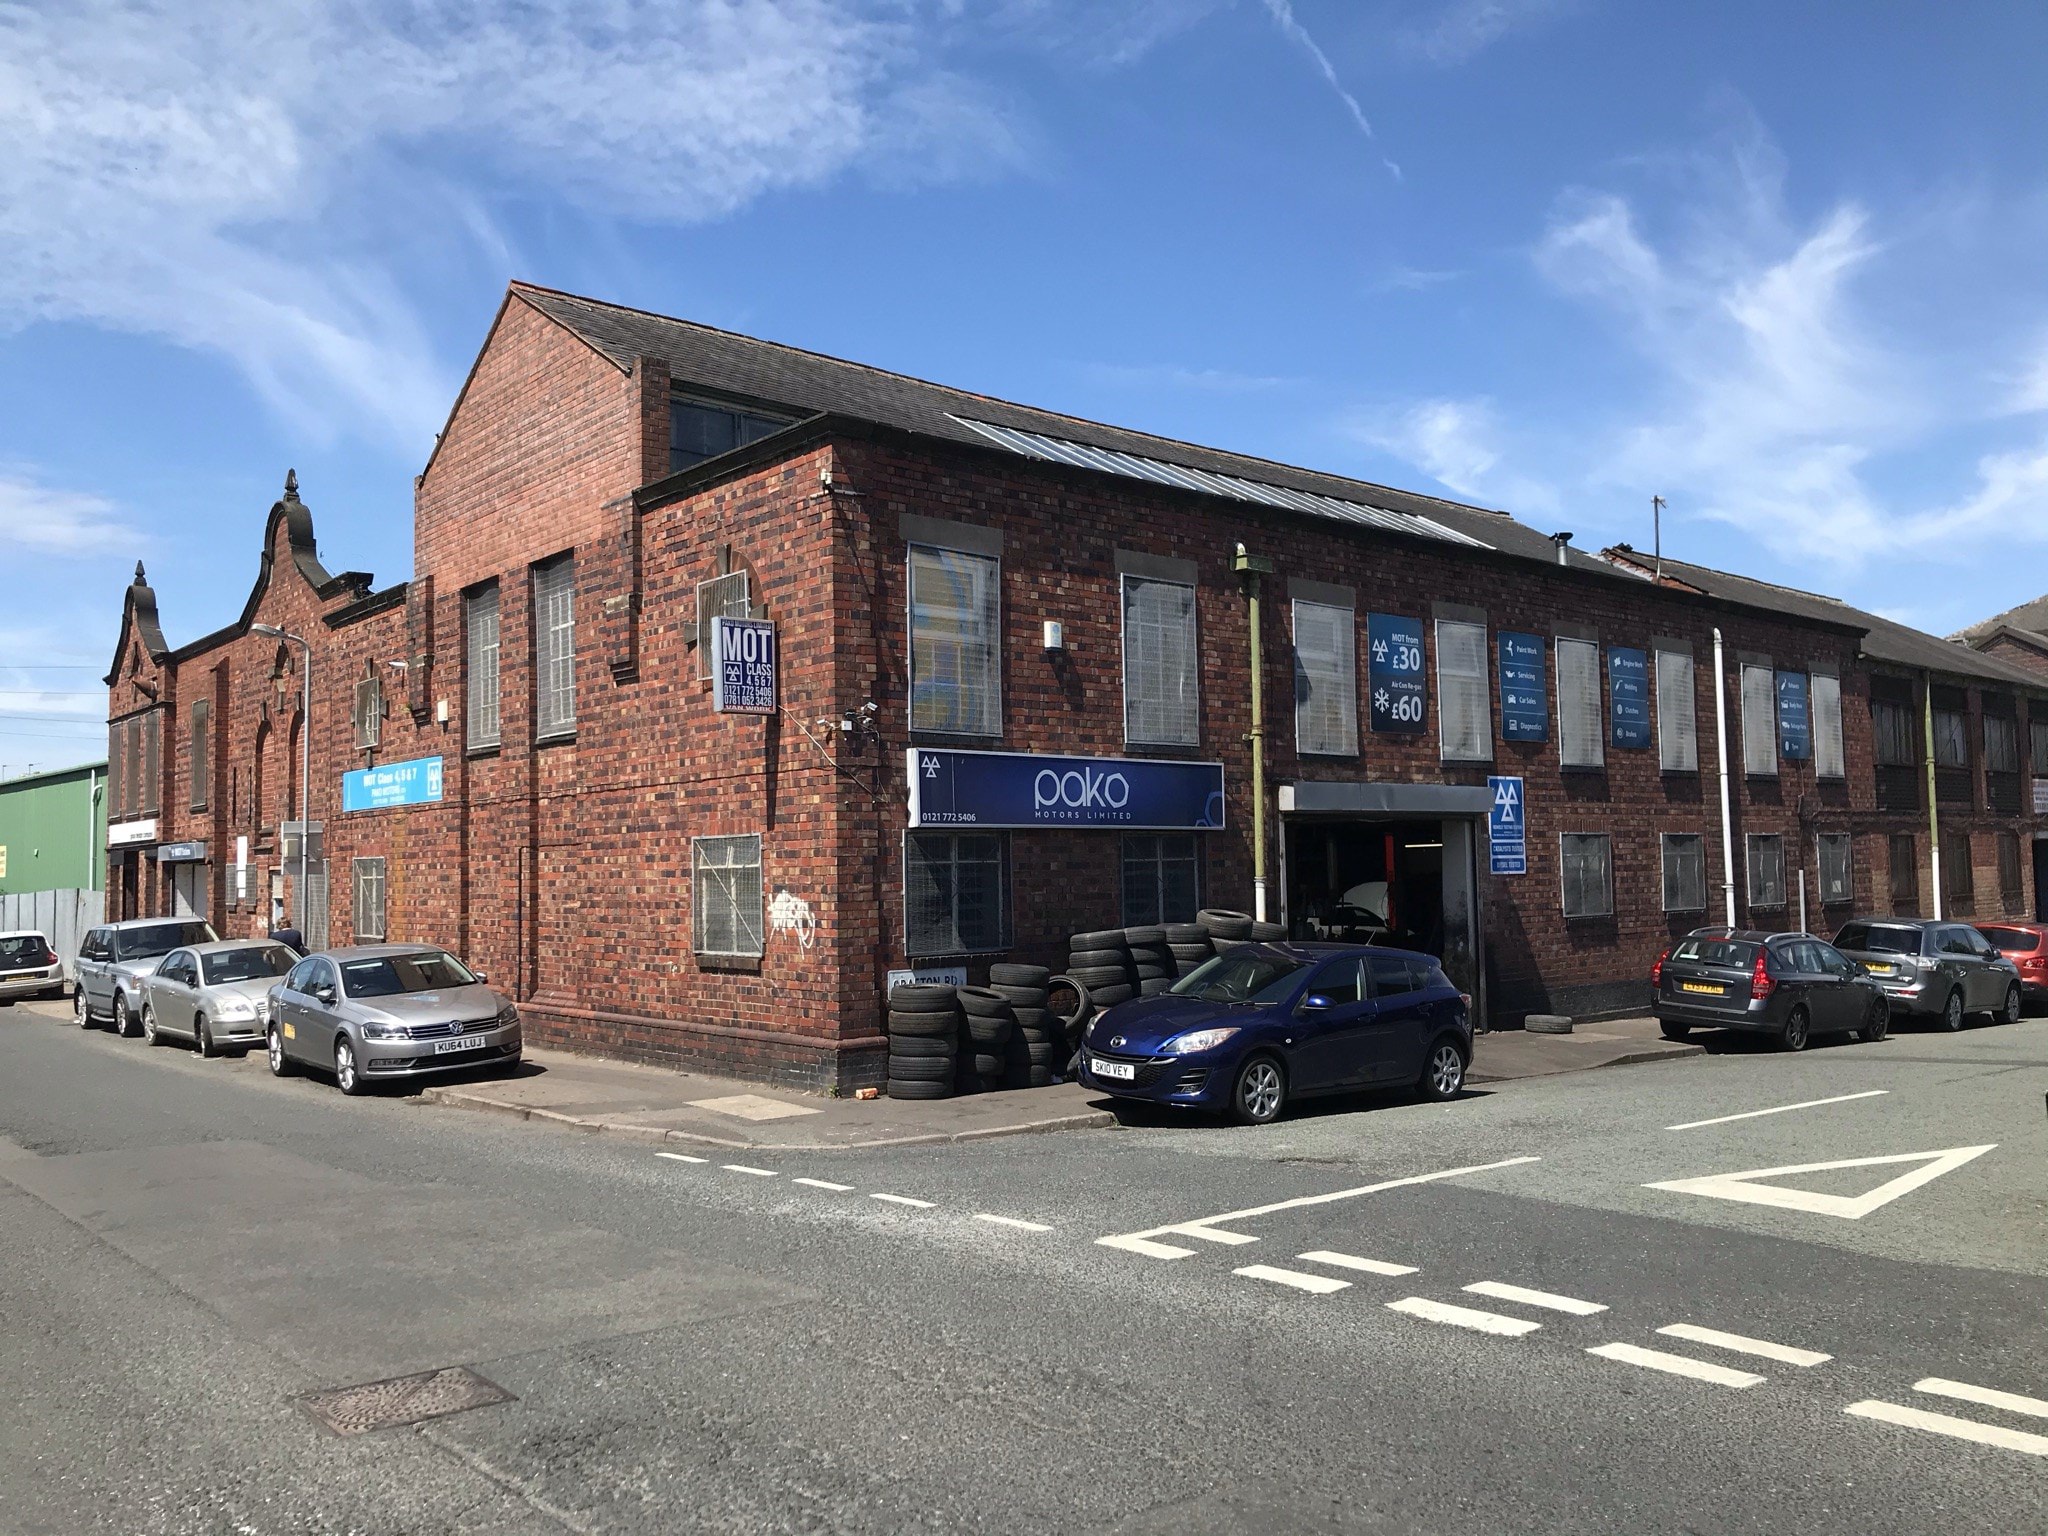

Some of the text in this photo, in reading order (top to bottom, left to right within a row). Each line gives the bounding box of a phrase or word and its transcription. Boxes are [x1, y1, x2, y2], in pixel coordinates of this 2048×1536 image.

[1392, 633, 1418, 644] MOT from
[722, 627, 771, 663] MOT
[1516, 646, 1526, 654] Paint
[1393, 646, 1420, 671] £30
[747, 663, 771, 676] CLASS
[755, 676, 759, 686] 5
[767, 677, 771, 687] 7
[1518, 672, 1536, 681] Servicing
[724, 685, 772, 697] 0121 772 5406
[724, 694, 772, 706] 0781 052 3426
[1392, 696, 1422, 722] £60
[1520, 722, 1542, 731] Diagnostics
[363, 774, 376, 787] MOT
[1034, 766, 1130, 810] pako
[922, 813, 976, 822] 0121 772 5406
[1035, 811, 1132, 820] MOTORS LIMITED
[944, 976, 958, 986] RD
[438, 1038, 482, 1052] KU64 LUJ
[1095, 1061, 1128, 1076] SK10 VEY
